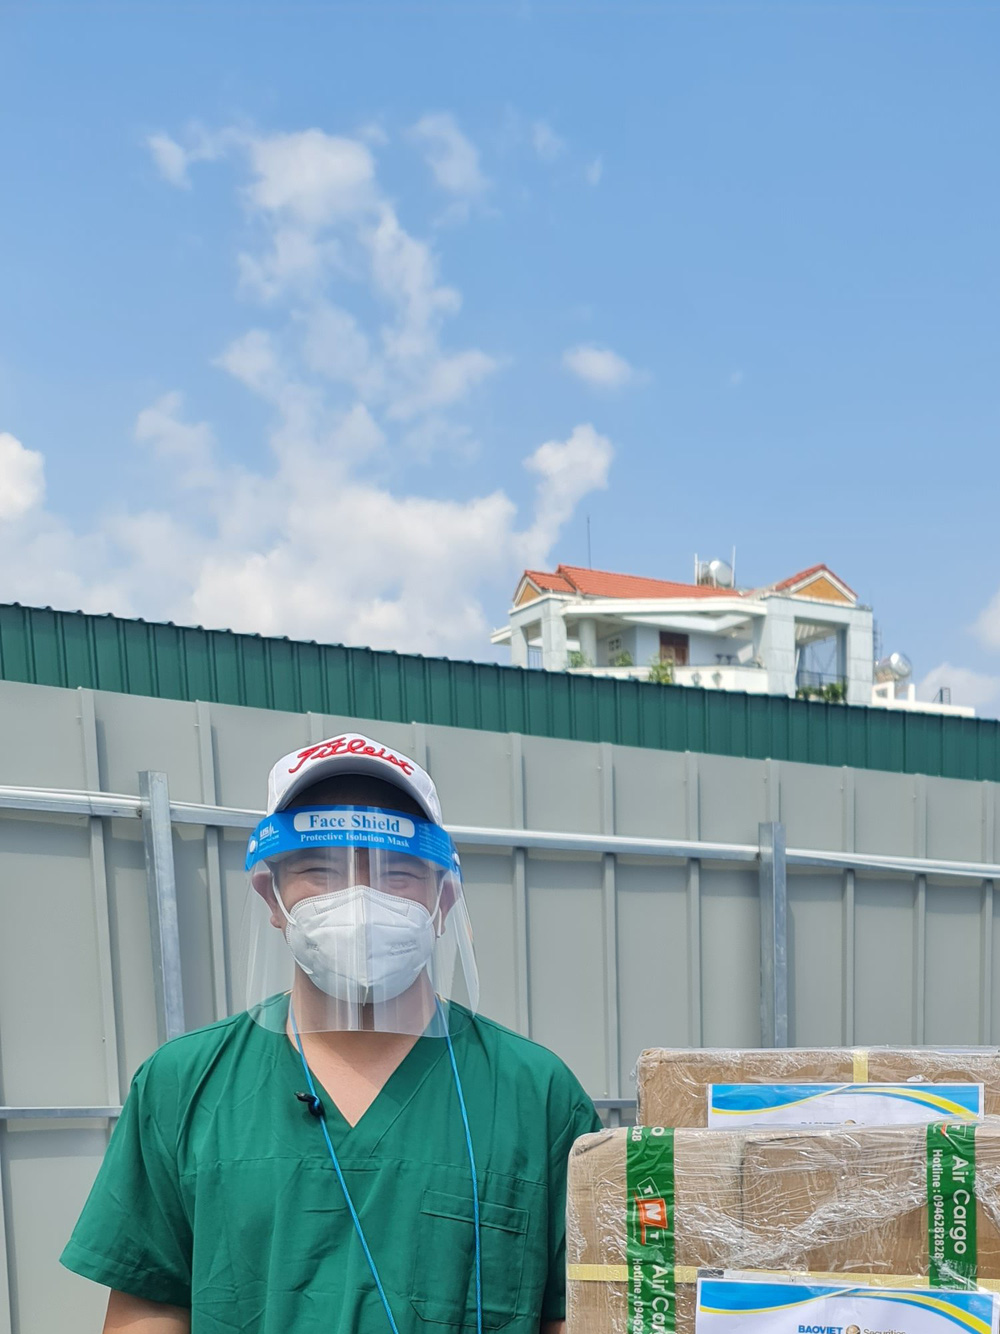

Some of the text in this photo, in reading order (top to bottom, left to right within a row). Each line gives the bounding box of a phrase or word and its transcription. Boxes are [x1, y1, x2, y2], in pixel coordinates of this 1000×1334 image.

[288, 736, 415, 776] Titleist
[300, 832, 410, 848] Protective Isolation Mask
[309, 814, 401, 834] Face Shield
[932, 1150, 944, 1187] Hotline
[949, 1155, 970, 1255] Air Cargo
[632, 1258, 643, 1294] Hotline
[651, 1264, 669, 1292] Air
